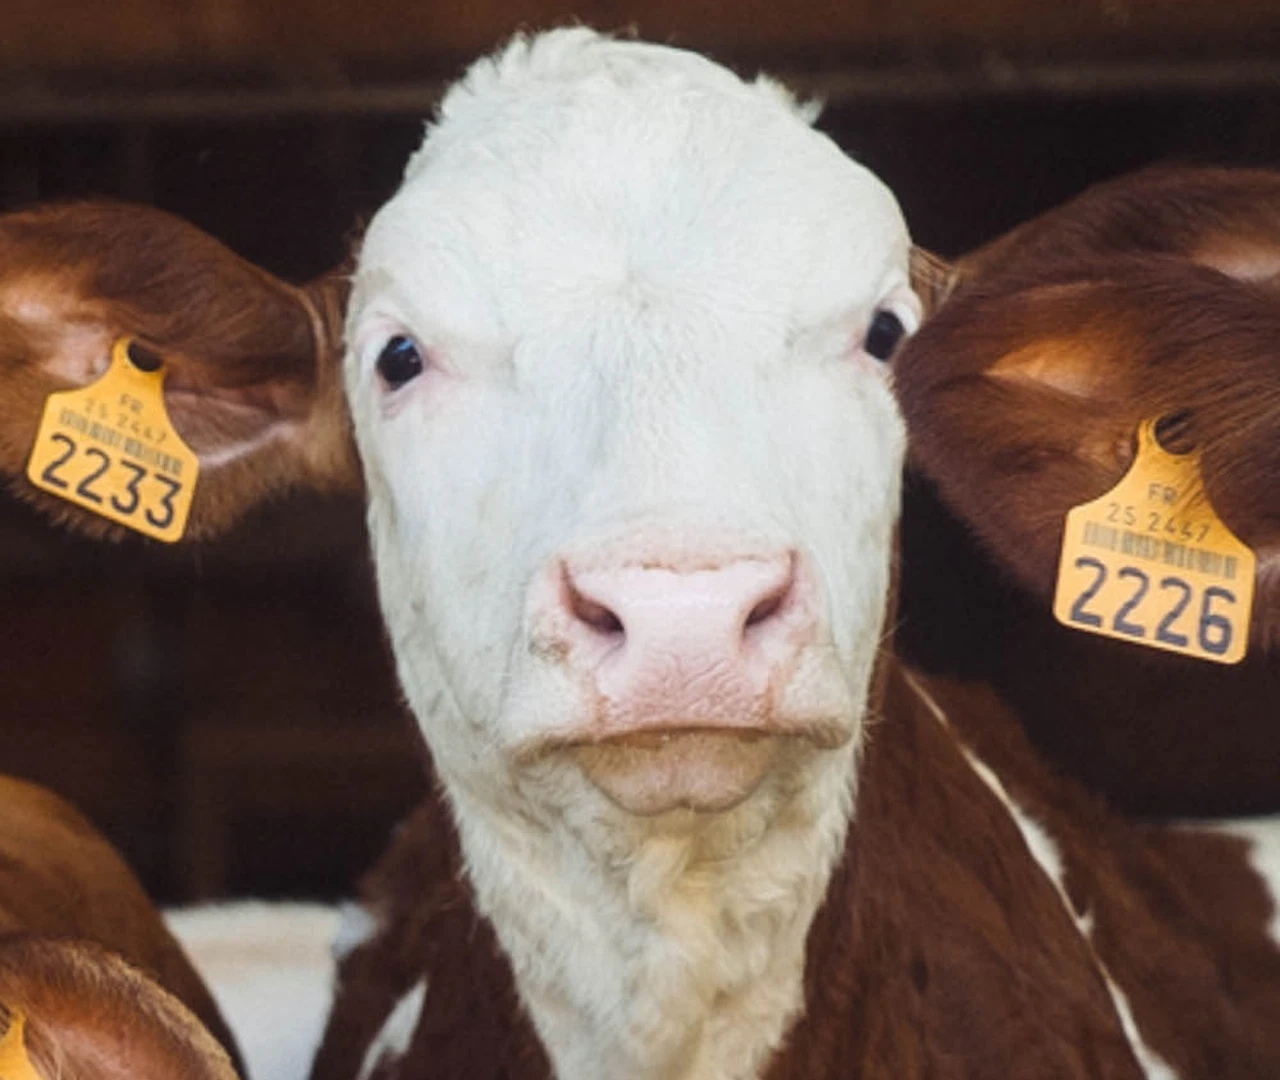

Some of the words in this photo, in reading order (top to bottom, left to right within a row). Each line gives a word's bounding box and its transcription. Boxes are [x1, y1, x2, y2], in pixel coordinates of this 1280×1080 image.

[41, 432, 182, 530] 2233
[1148, 483, 1177, 505] FR
[1106, 503, 1136, 526] 25
[1147, 511, 1211, 542] 2447
[1070, 556, 1236, 656] 2226
